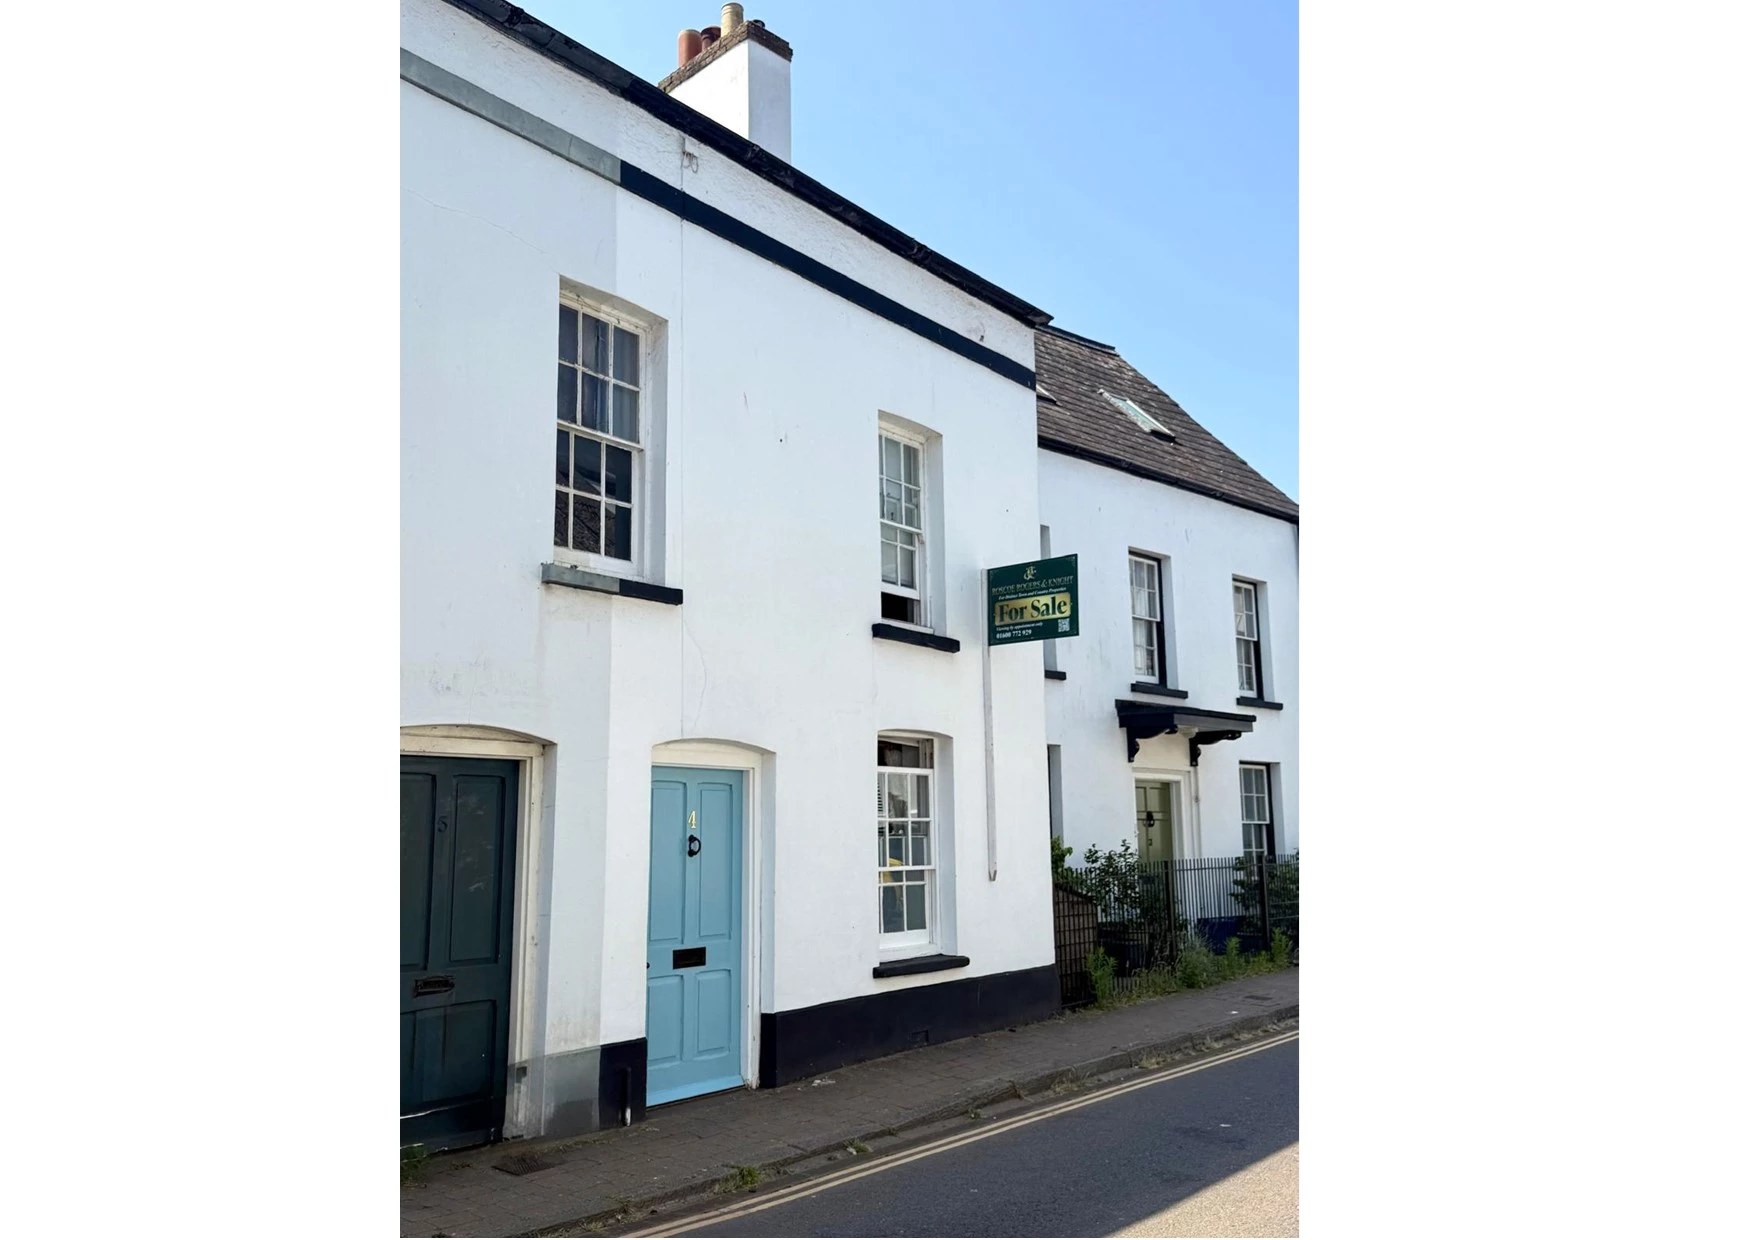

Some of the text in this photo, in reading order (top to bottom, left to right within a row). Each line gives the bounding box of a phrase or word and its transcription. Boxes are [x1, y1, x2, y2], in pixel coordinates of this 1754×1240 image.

[1041, 579, 1047, 588] &
[1048, 576, 1074, 587] KNIGHT
[998, 596, 1067, 623] For Sale
[437, 815, 448, 833] 5
[688, 810, 697, 829] 4
